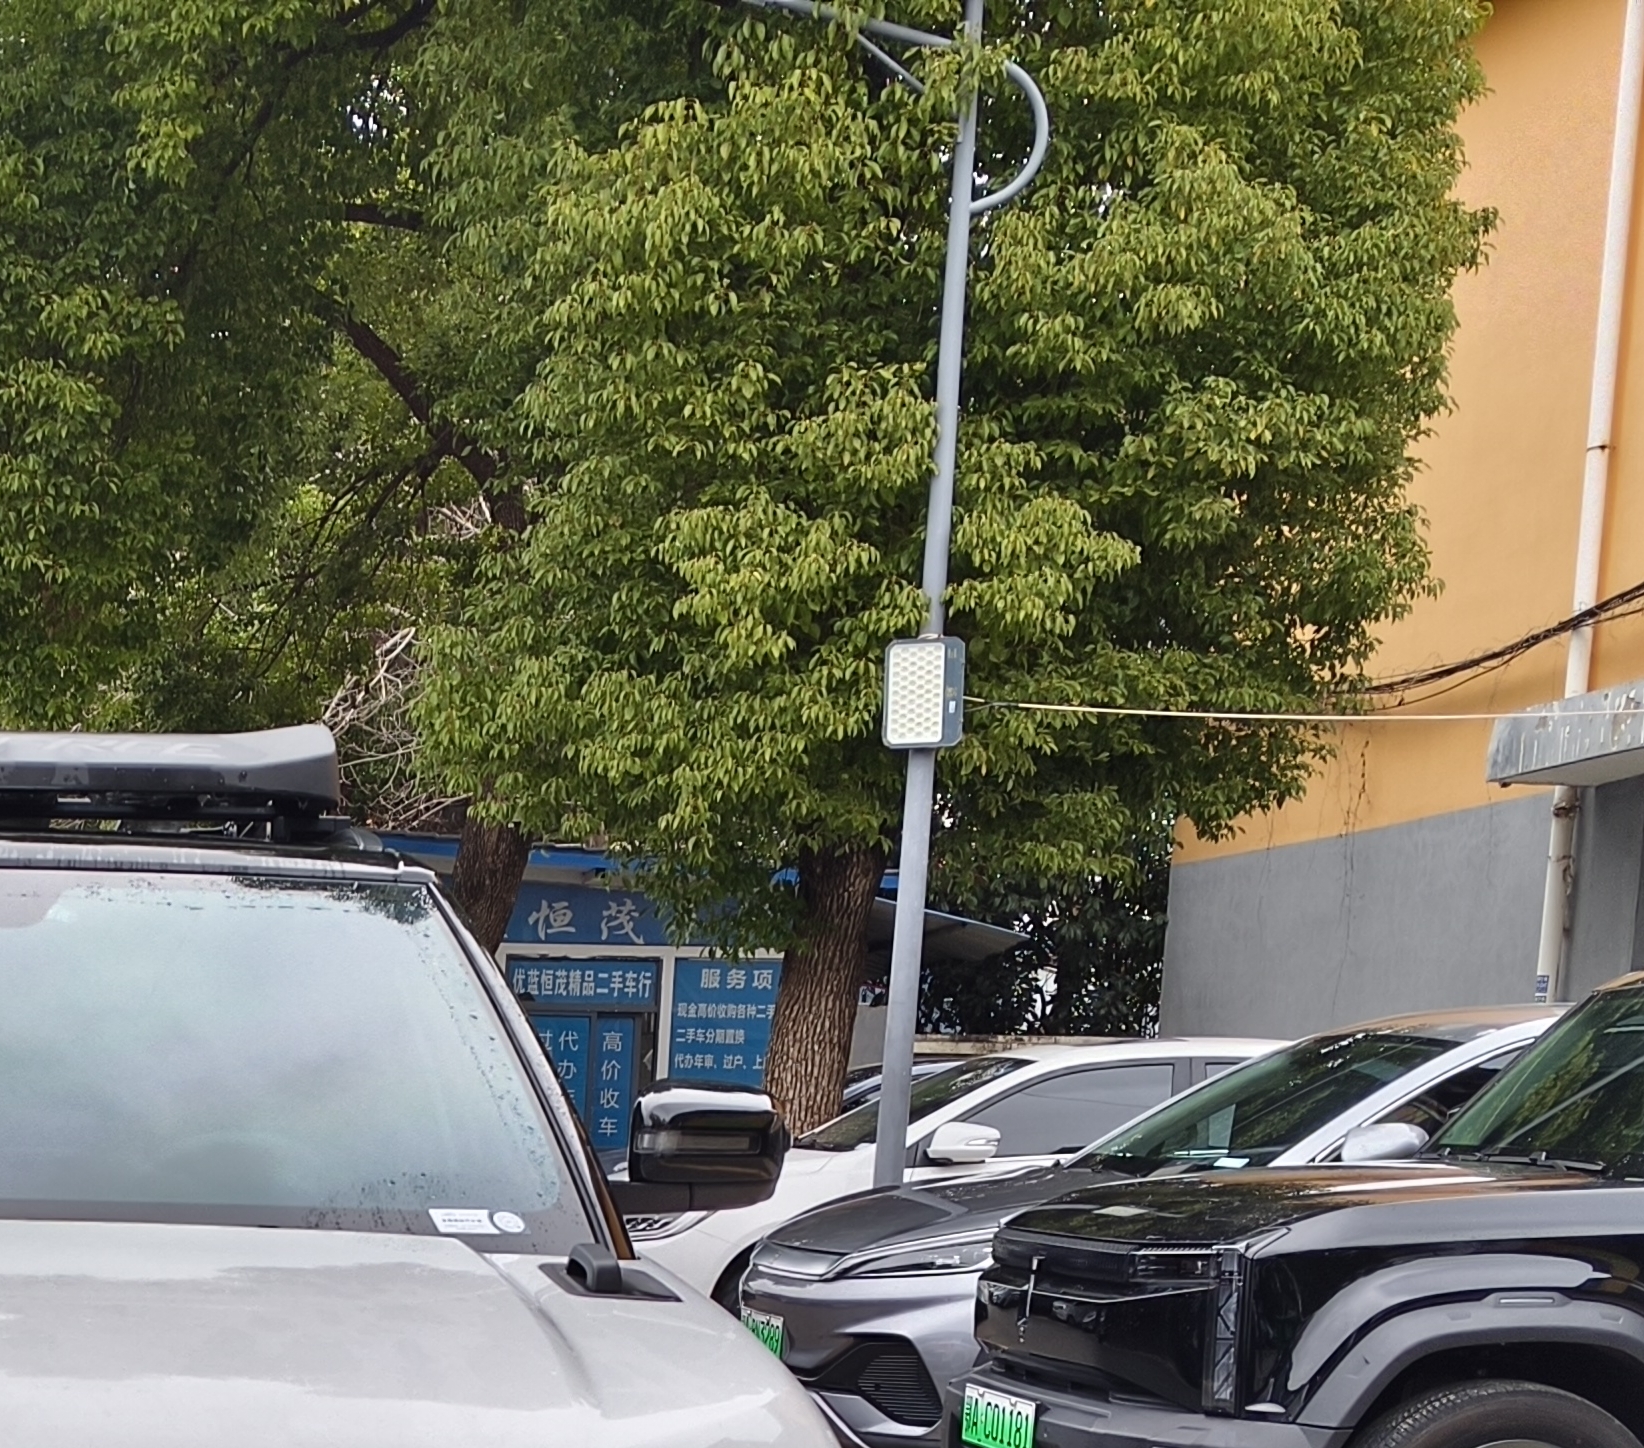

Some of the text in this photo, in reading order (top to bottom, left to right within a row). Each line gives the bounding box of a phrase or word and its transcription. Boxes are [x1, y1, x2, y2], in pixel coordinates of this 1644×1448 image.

[527, 898, 645, 944] 恒茂
[512, 967, 653, 999] 优蓝恒茂精品二手车行
[700, 967, 774, 990] 服务项
[557, 1030, 579, 1104] 代办
[674, 1053, 767, 1070] 代办年审、过户、上
[597, 1030, 624, 1138] 高价收车
